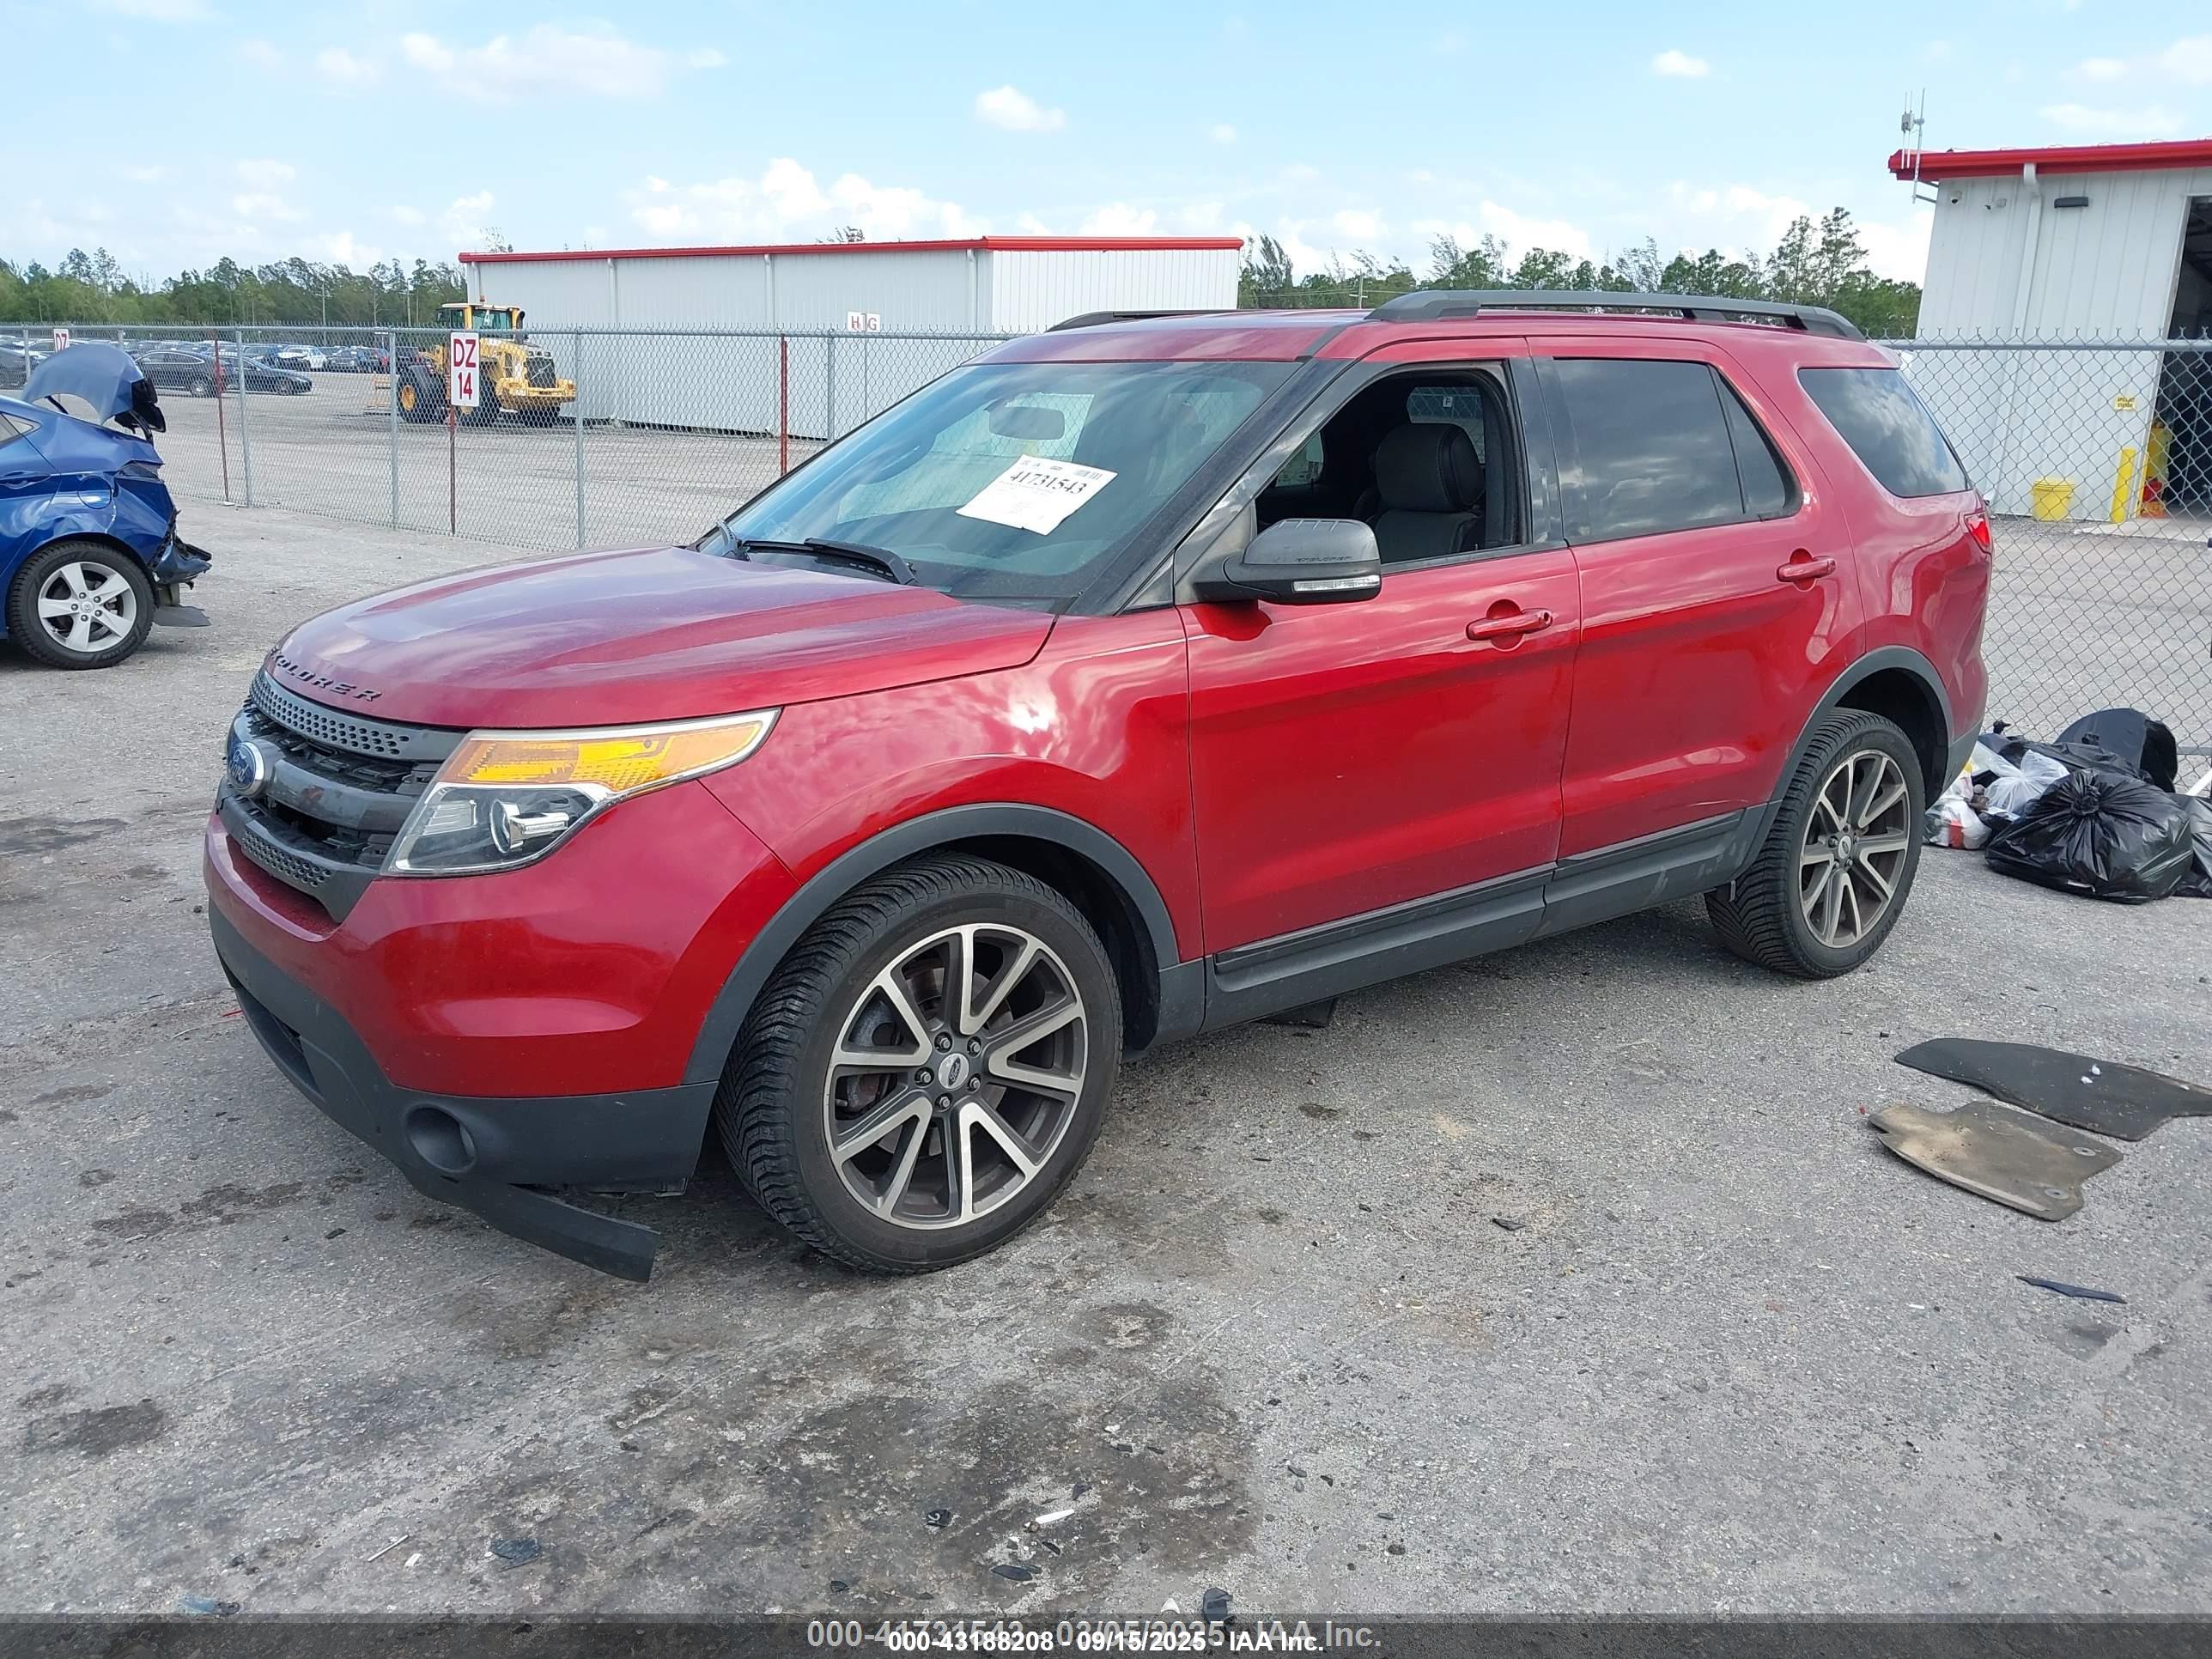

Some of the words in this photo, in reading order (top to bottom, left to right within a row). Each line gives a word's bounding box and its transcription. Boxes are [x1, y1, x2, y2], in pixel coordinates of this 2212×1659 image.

[453, 338, 477, 368] DZ
[458, 372, 472, 400] 14
[1010, 471, 1087, 495] 41731543
